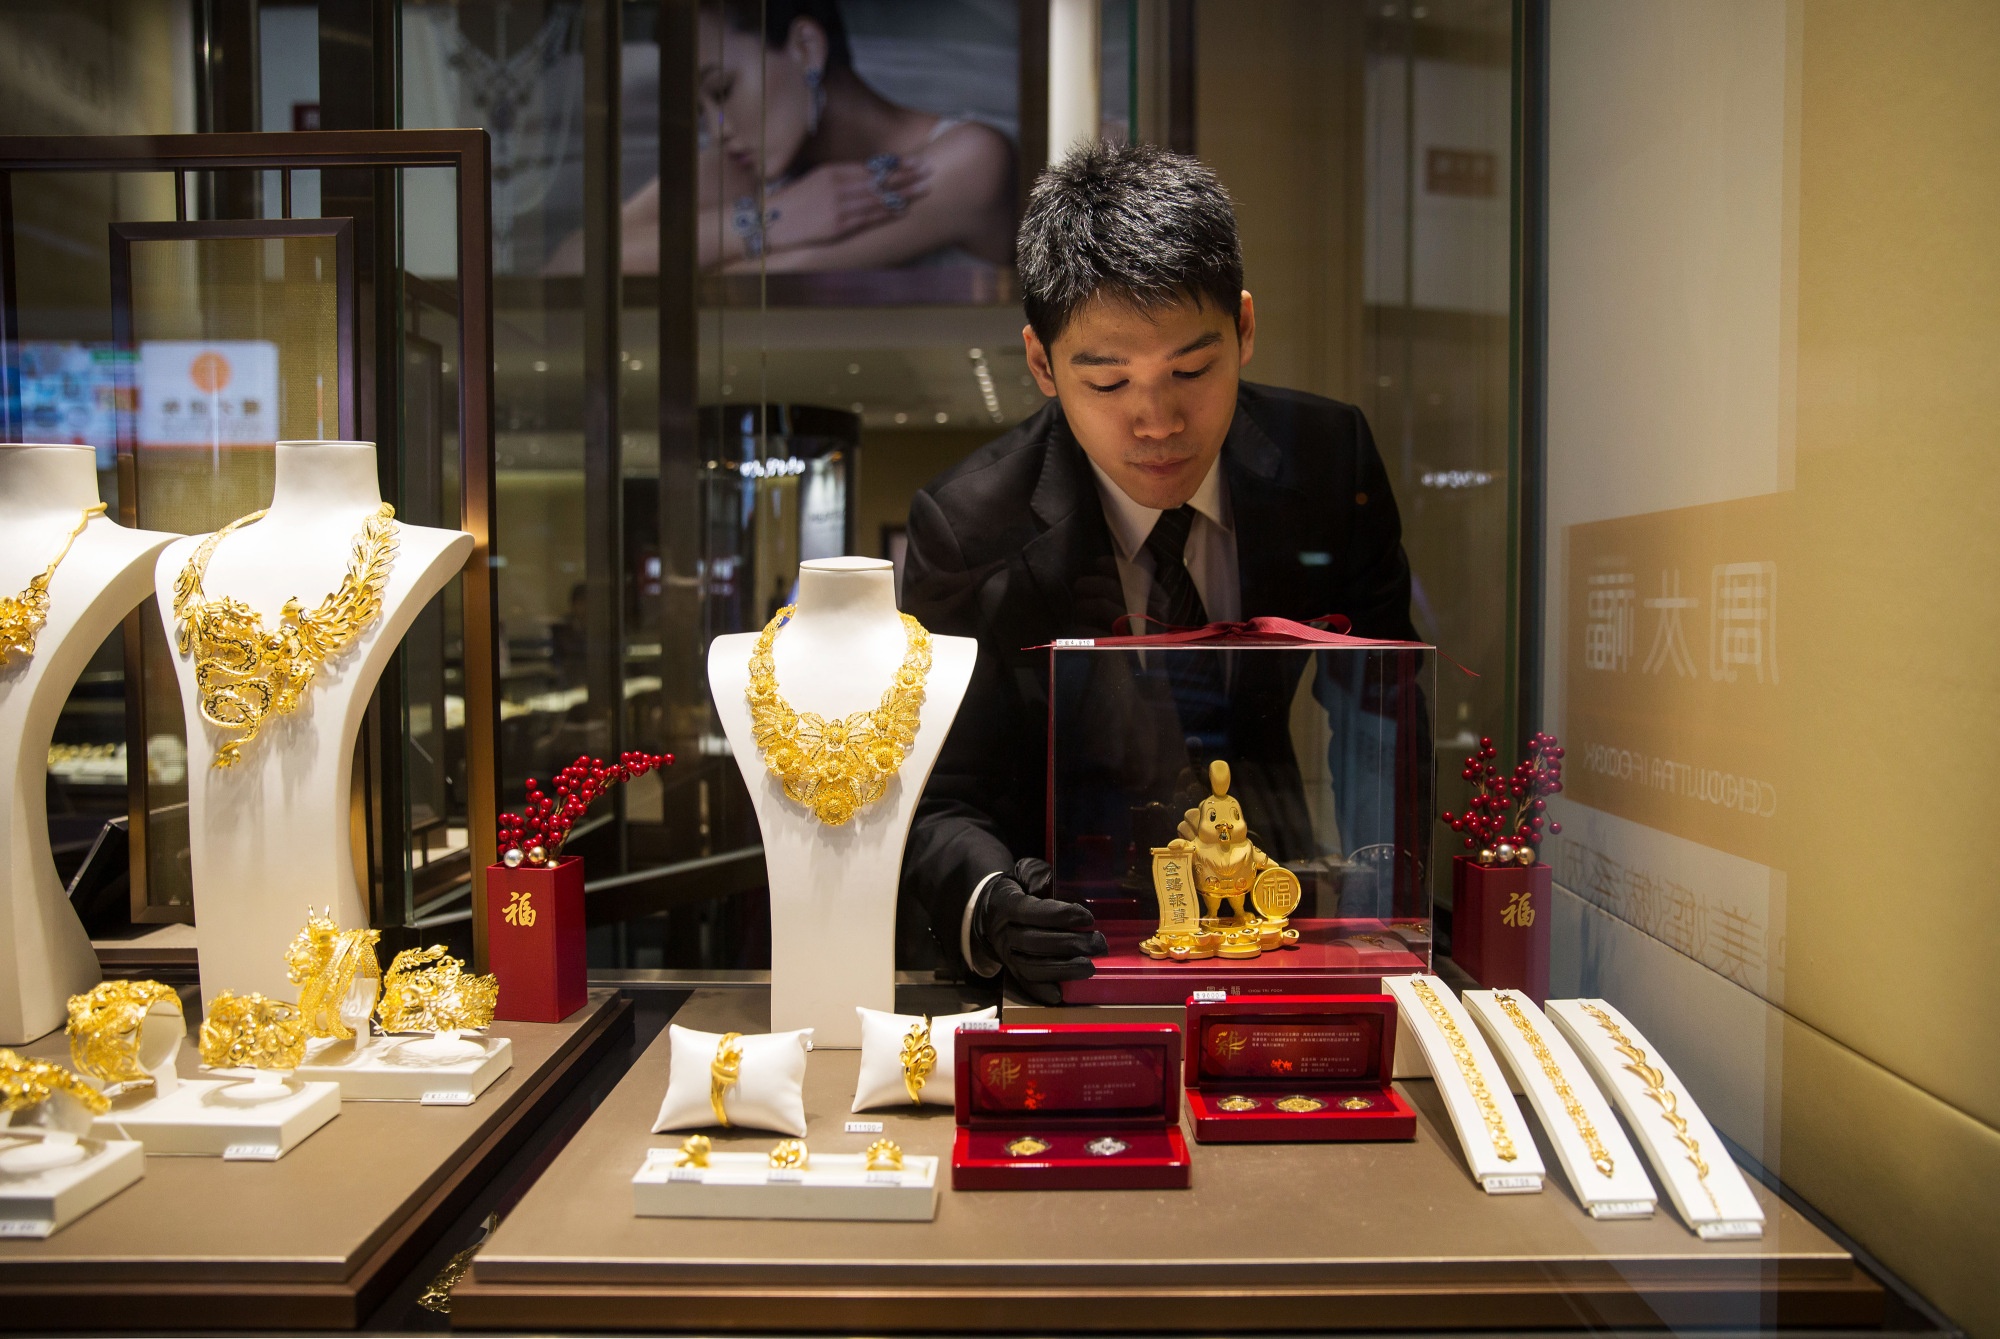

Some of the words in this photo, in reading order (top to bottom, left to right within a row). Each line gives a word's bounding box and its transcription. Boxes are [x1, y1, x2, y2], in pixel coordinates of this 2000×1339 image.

[501, 891, 537, 927] 福
[1263, 876, 1292, 909] 福
[1500, 891, 1536, 927] 福
